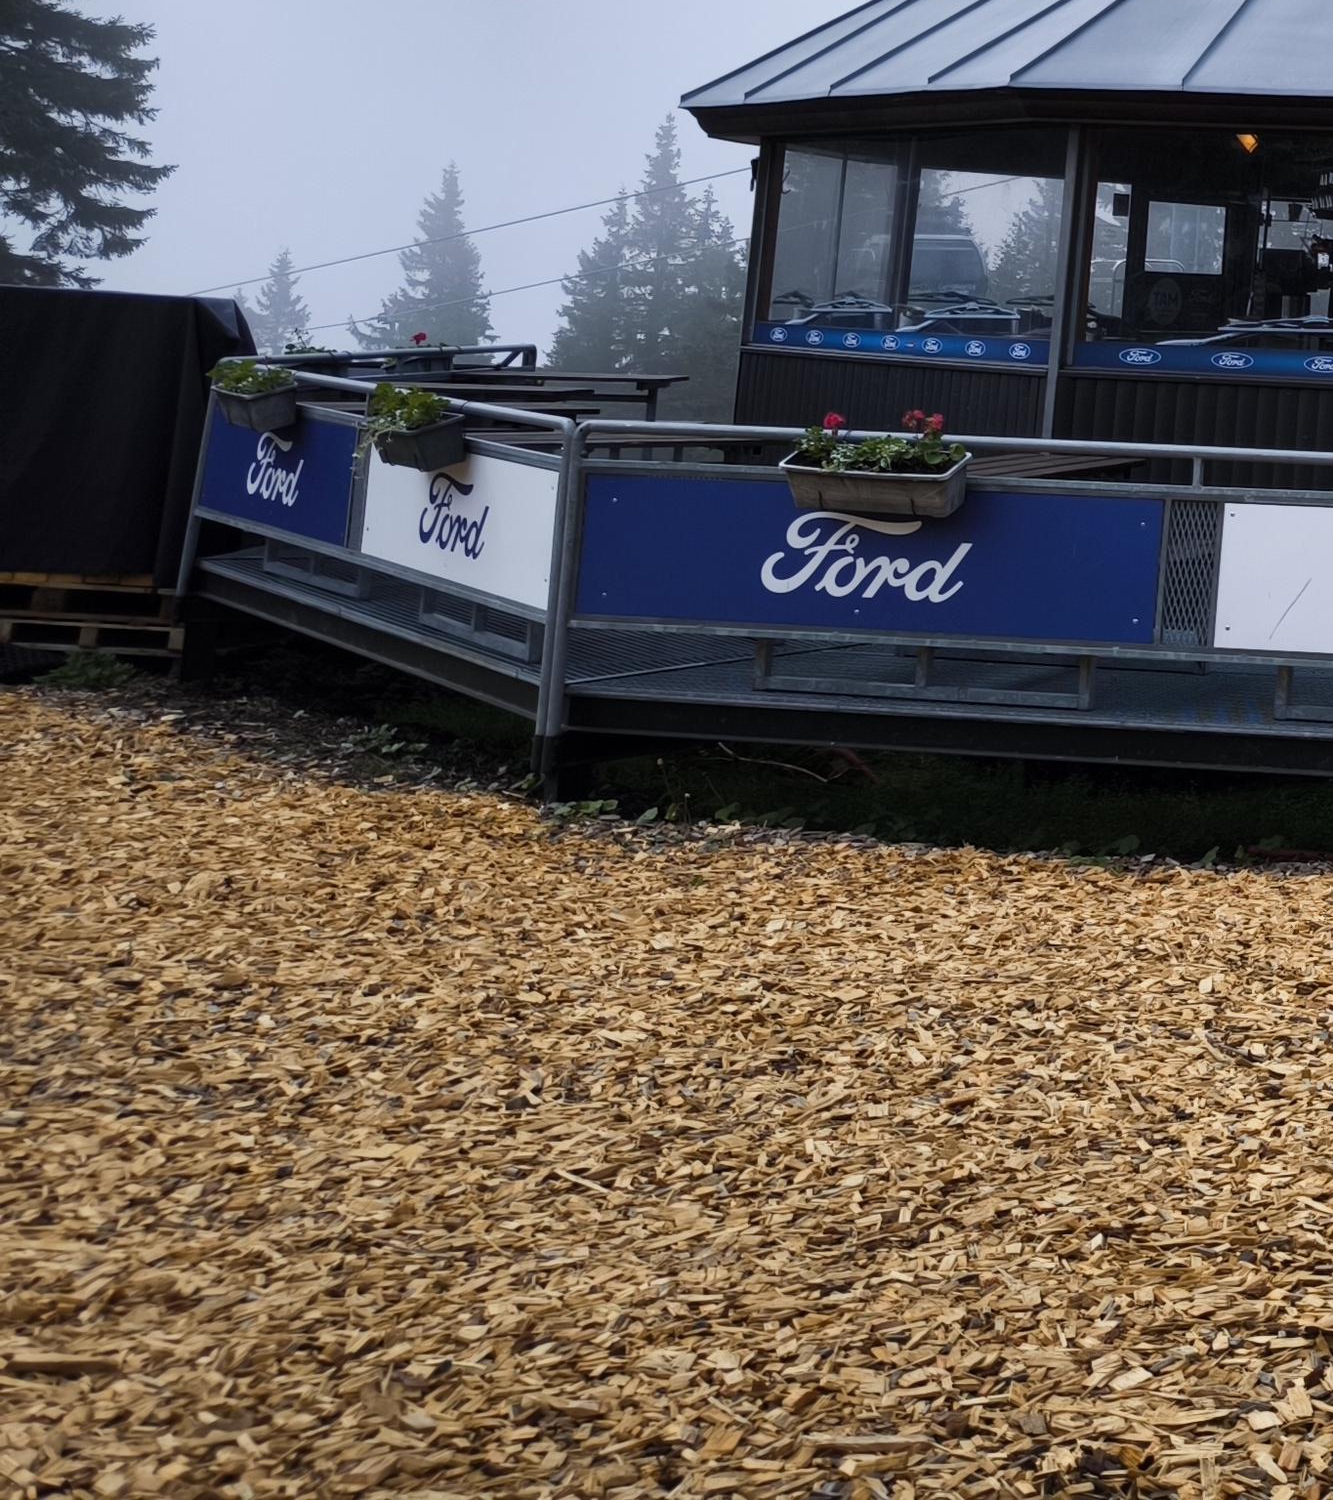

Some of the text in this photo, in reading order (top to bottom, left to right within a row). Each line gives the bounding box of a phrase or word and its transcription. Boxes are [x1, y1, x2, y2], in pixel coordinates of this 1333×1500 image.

[246, 431, 304, 507] Ford
[419, 472, 490, 560] Ford
[760, 511, 973, 603] Ford
